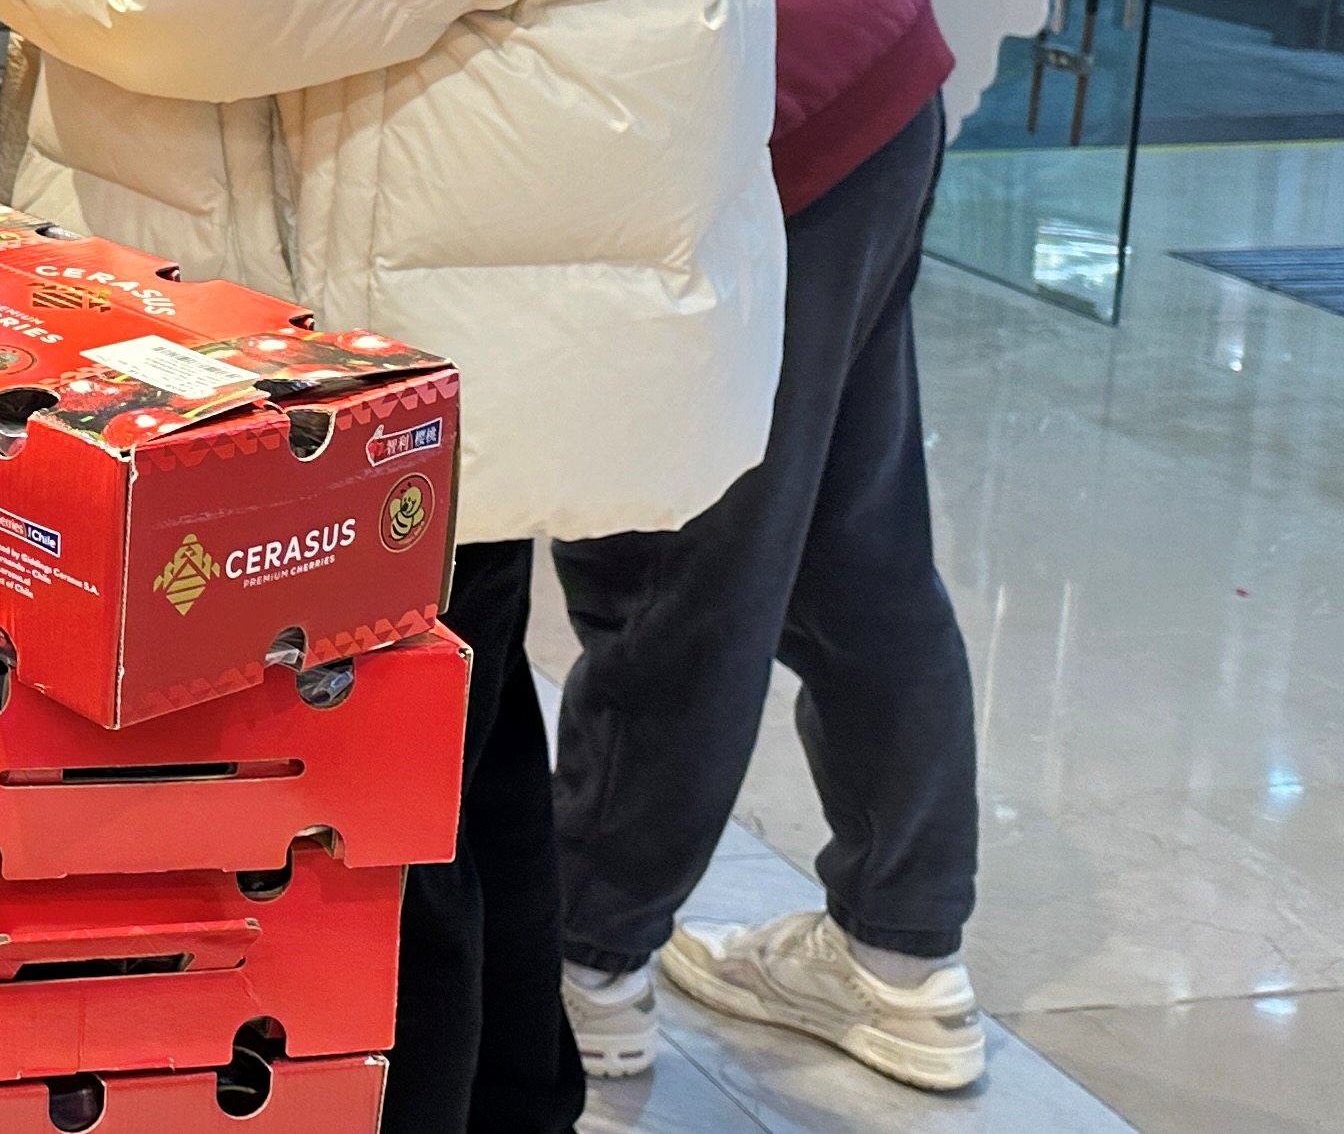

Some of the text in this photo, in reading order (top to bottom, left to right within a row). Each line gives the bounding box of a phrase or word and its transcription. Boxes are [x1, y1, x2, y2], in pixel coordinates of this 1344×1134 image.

[34, 264, 176, 317] CERASUS
[385, 438, 410, 456] 智利
[31, 528, 56, 550] Chile
[225, 518, 357, 579] CERASUS
[5, 578, 14, 590] of
[243, 554, 336, 589] PREMIUM CHERRIES
